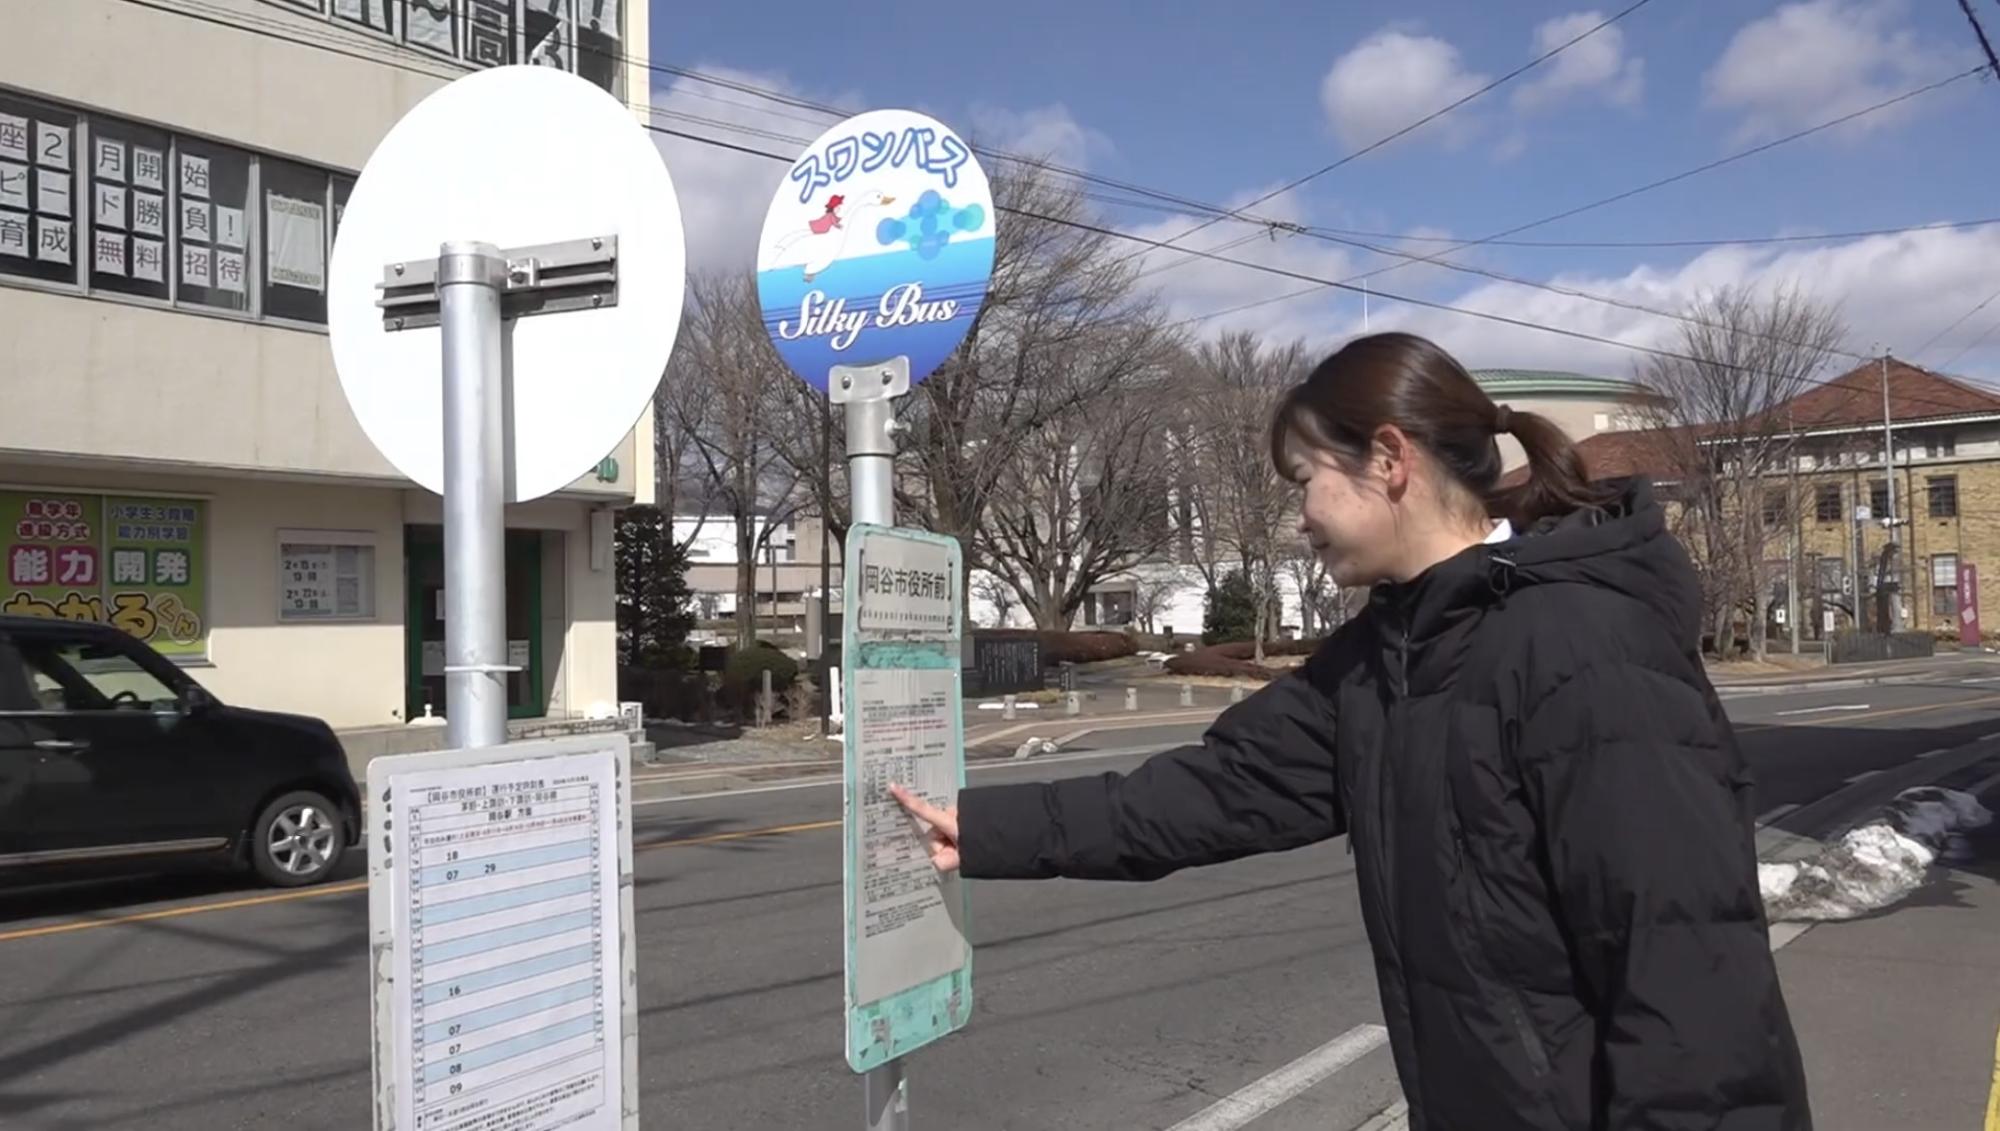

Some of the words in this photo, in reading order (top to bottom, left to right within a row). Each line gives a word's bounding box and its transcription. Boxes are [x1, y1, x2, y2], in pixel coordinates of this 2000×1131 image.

[791, 127, 968, 204] スワンバス
[0, 219, 242, 284] 育成無料招待
[779, 290, 871, 351] Silky
[875, 281, 961, 329] Bus
[865, 564, 946, 600] 岡谷市役所前
[446, 851, 458, 861] 18
[446, 870, 459, 881] 07
[484, 863, 496, 874] 29
[448, 986, 461, 997] 16
[448, 1025, 461, 1036] 07
[449, 1044, 461, 1055] 07
[449, 1063, 462, 1075] 08
[449, 1082, 462, 1094] 09
